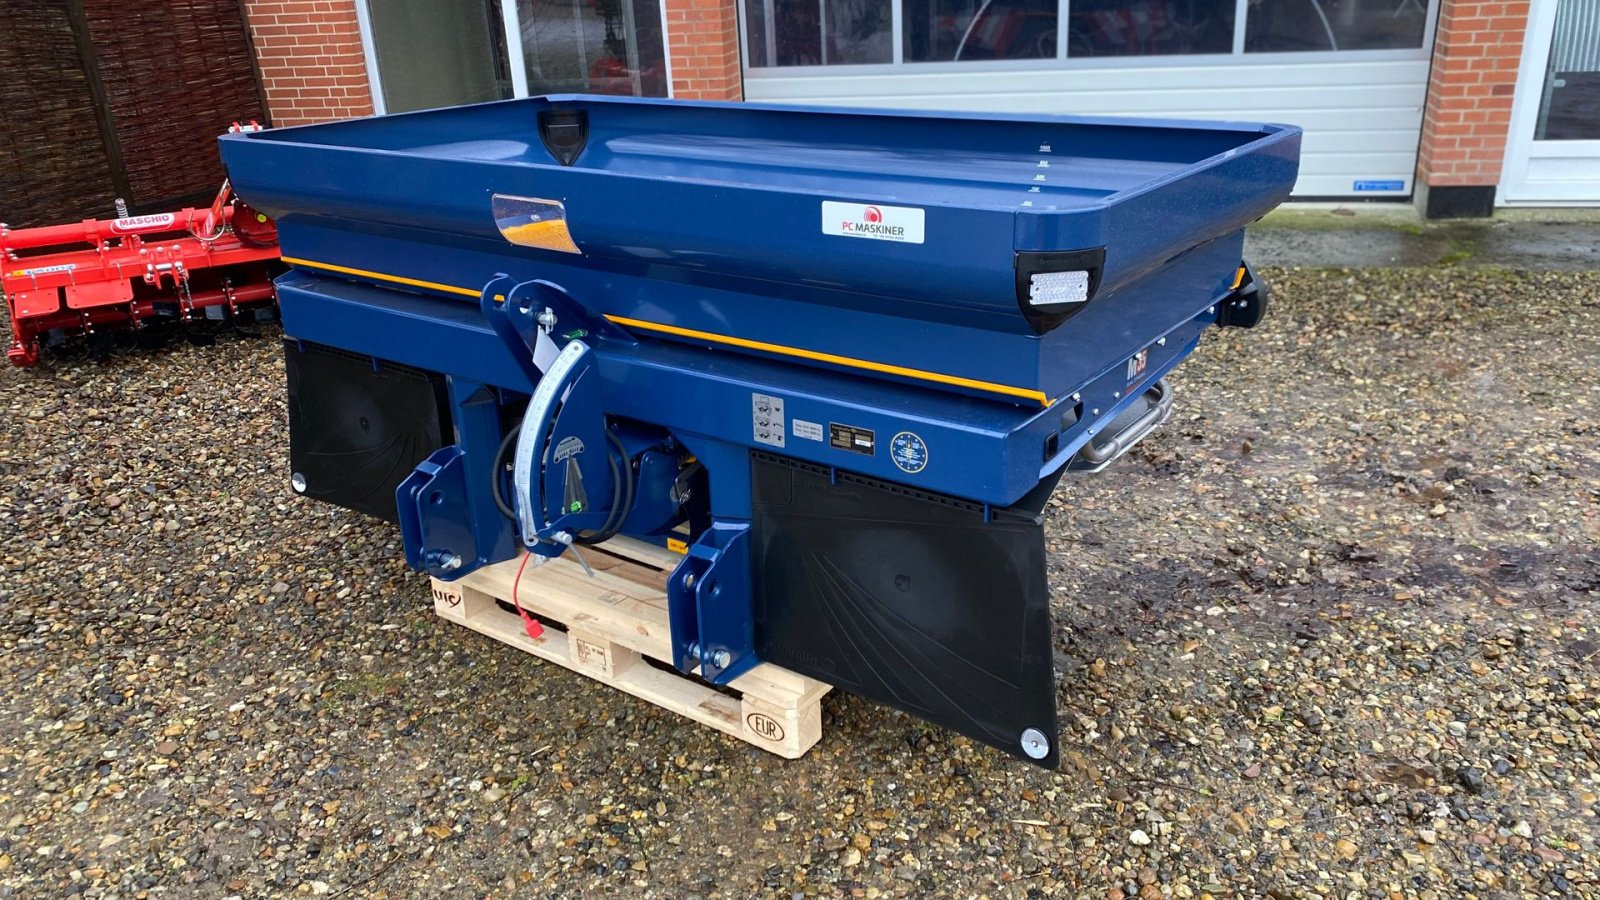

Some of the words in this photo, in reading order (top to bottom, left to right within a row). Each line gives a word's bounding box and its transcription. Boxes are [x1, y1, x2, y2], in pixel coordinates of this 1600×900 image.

[118, 214, 170, 227] MASCHIO
[842, 221, 854, 231] PC
[855, 223, 905, 236] MASKINER
[755, 716, 777, 738] EUR
